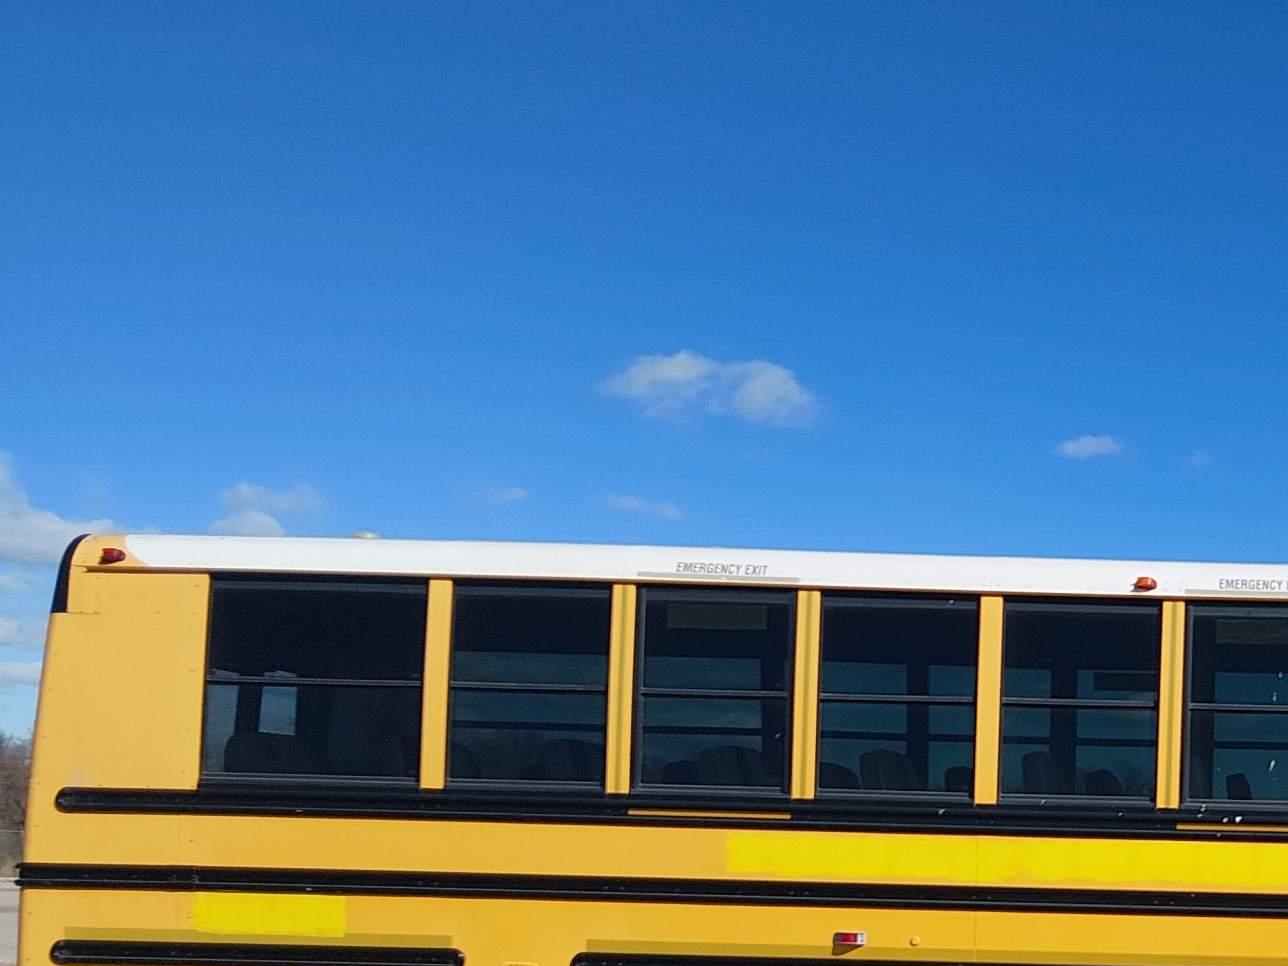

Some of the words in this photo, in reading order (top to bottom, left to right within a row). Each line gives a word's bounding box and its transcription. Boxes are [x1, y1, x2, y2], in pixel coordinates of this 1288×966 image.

[676, 561, 743, 576] EMERGENCY
[744, 564, 769, 576] EXIT
[1218, 578, 1283, 591] EMERGENCY
